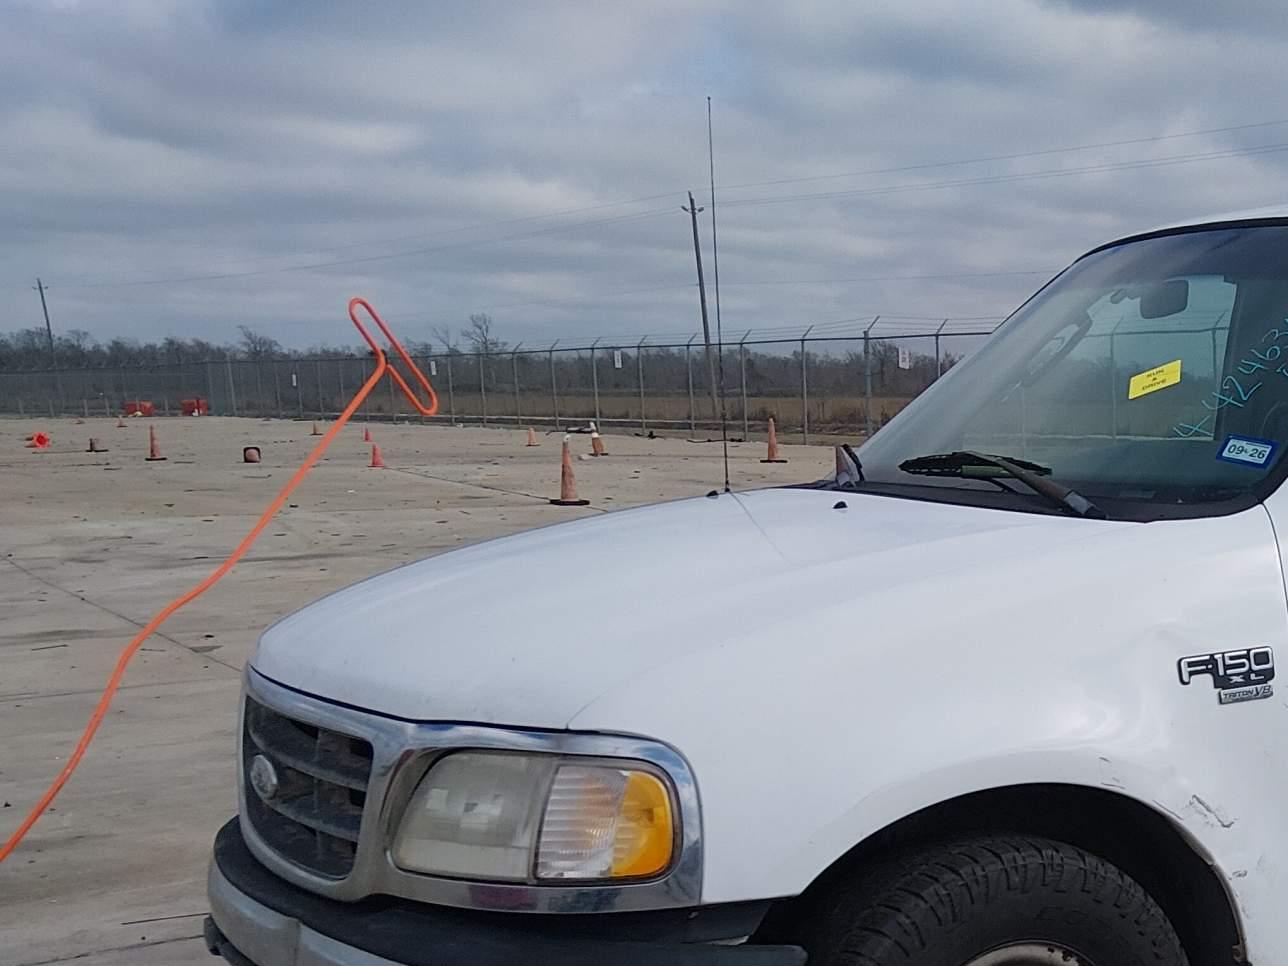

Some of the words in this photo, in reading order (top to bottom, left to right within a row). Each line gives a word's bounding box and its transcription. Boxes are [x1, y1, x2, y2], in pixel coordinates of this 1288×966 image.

[1180, 646, 1274, 684] F-150
[1228, 672, 1265, 684] XL
[1222, 689, 1254, 700] TRITON
